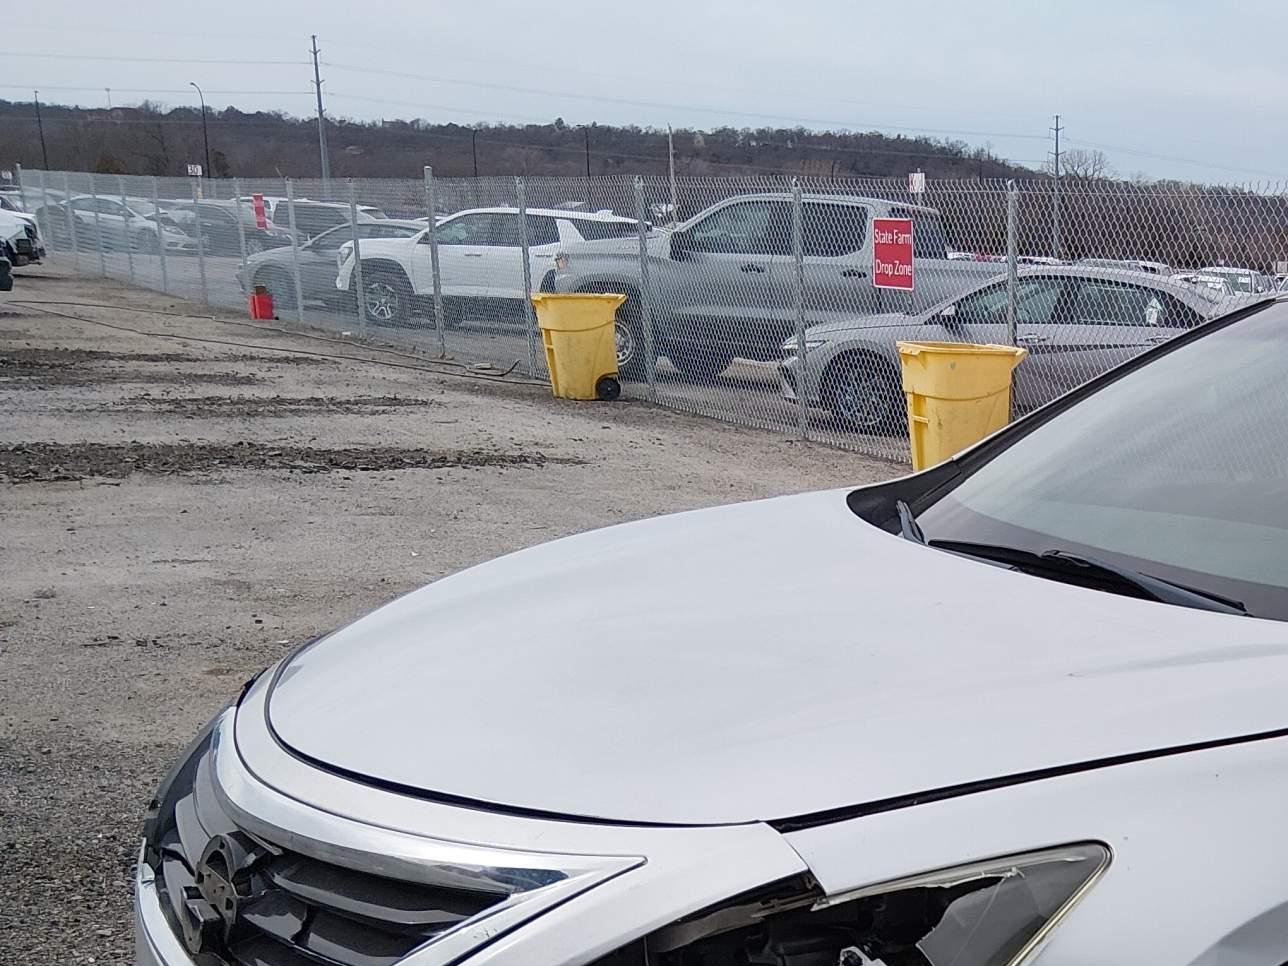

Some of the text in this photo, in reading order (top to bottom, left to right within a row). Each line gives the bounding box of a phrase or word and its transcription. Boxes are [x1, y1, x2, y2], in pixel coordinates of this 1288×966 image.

[874, 229, 912, 245] State Farm
[875, 260, 912, 277] Drop Zone
